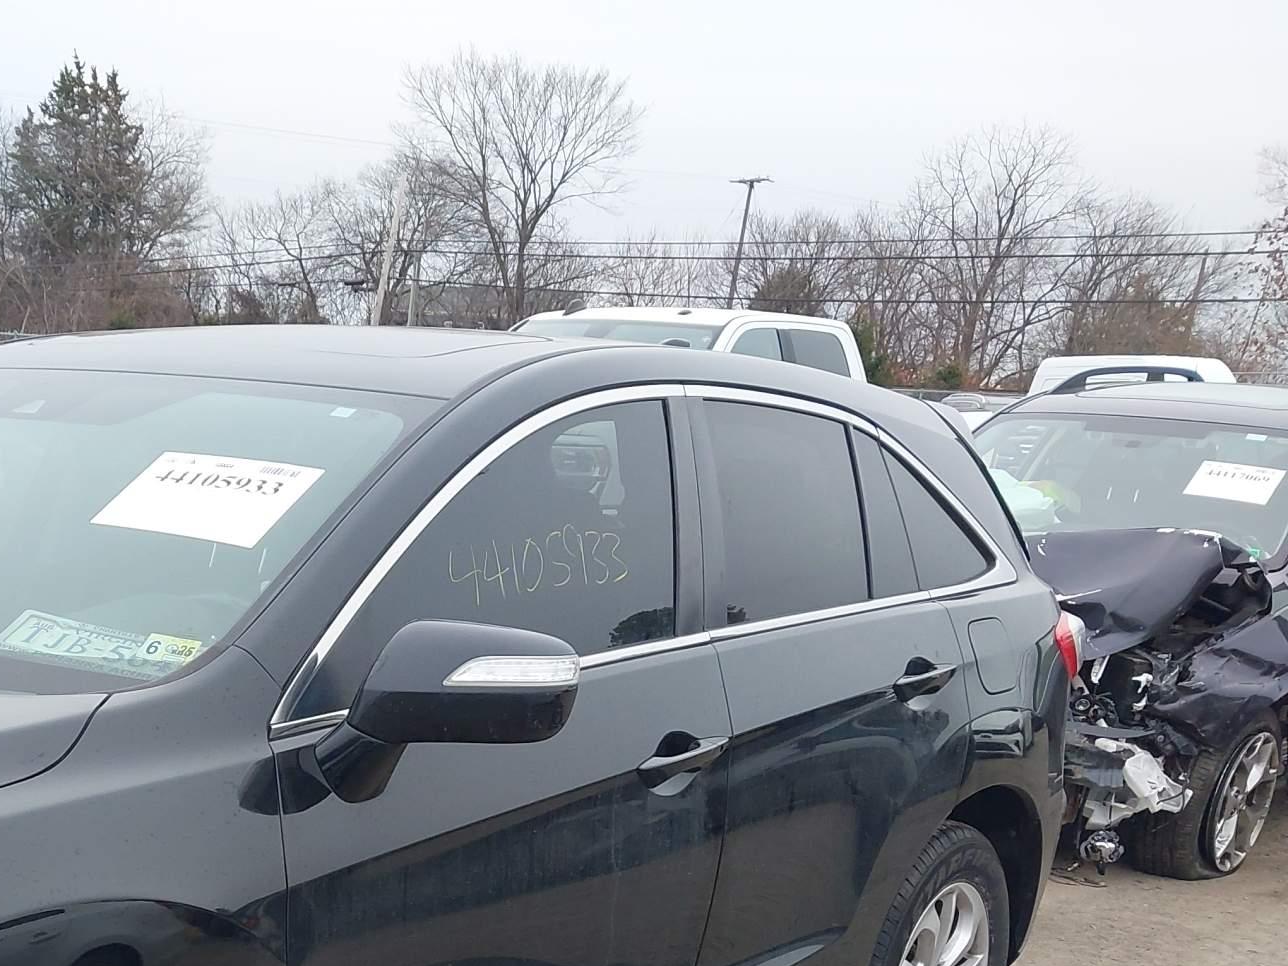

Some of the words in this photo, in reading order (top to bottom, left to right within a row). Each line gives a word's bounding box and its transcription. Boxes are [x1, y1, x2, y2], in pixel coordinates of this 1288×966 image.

[156, 470, 284, 496] 44105933
[448, 523, 629, 607] 44105933
[146, 640, 162, 655] 6
